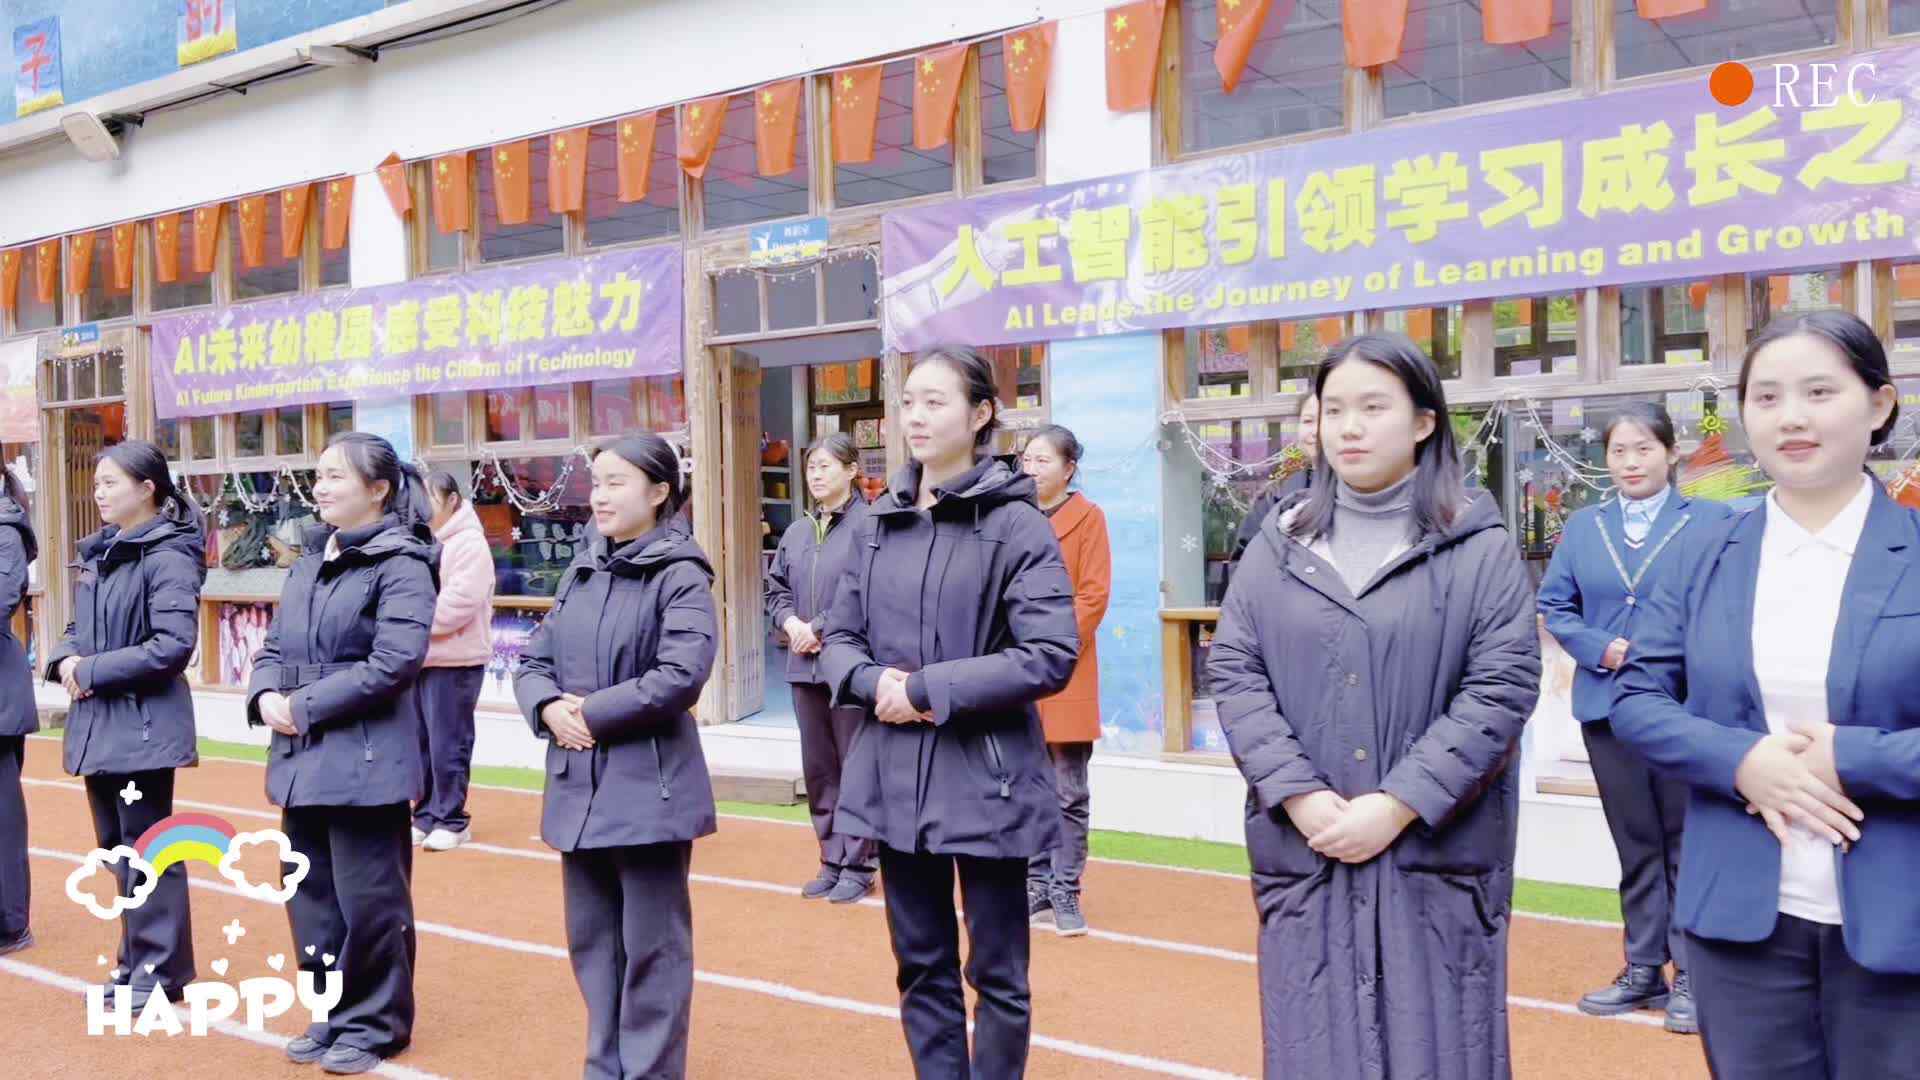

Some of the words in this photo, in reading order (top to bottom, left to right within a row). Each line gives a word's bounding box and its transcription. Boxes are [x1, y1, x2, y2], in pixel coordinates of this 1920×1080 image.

[22, 33, 51, 93] 子
[939, 92, 1906, 298] 人工智能引领学习成长之
[1005, 305, 1034, 329] AI
[1043, 297, 1134, 327] Leads
[1142, 290, 1194, 317] the
[1204, 274, 1352, 309] Journey
[1365, 262, 1401, 293] of
[1414, 245, 1605, 289] Learning
[1617, 230, 1703, 268] and
[1718, 207, 1906, 257] Growth
[416, 363, 441, 383] the
[445, 358, 501, 379] Charm
[506, 352, 522, 376] of
[528, 345, 637, 372] Technology
